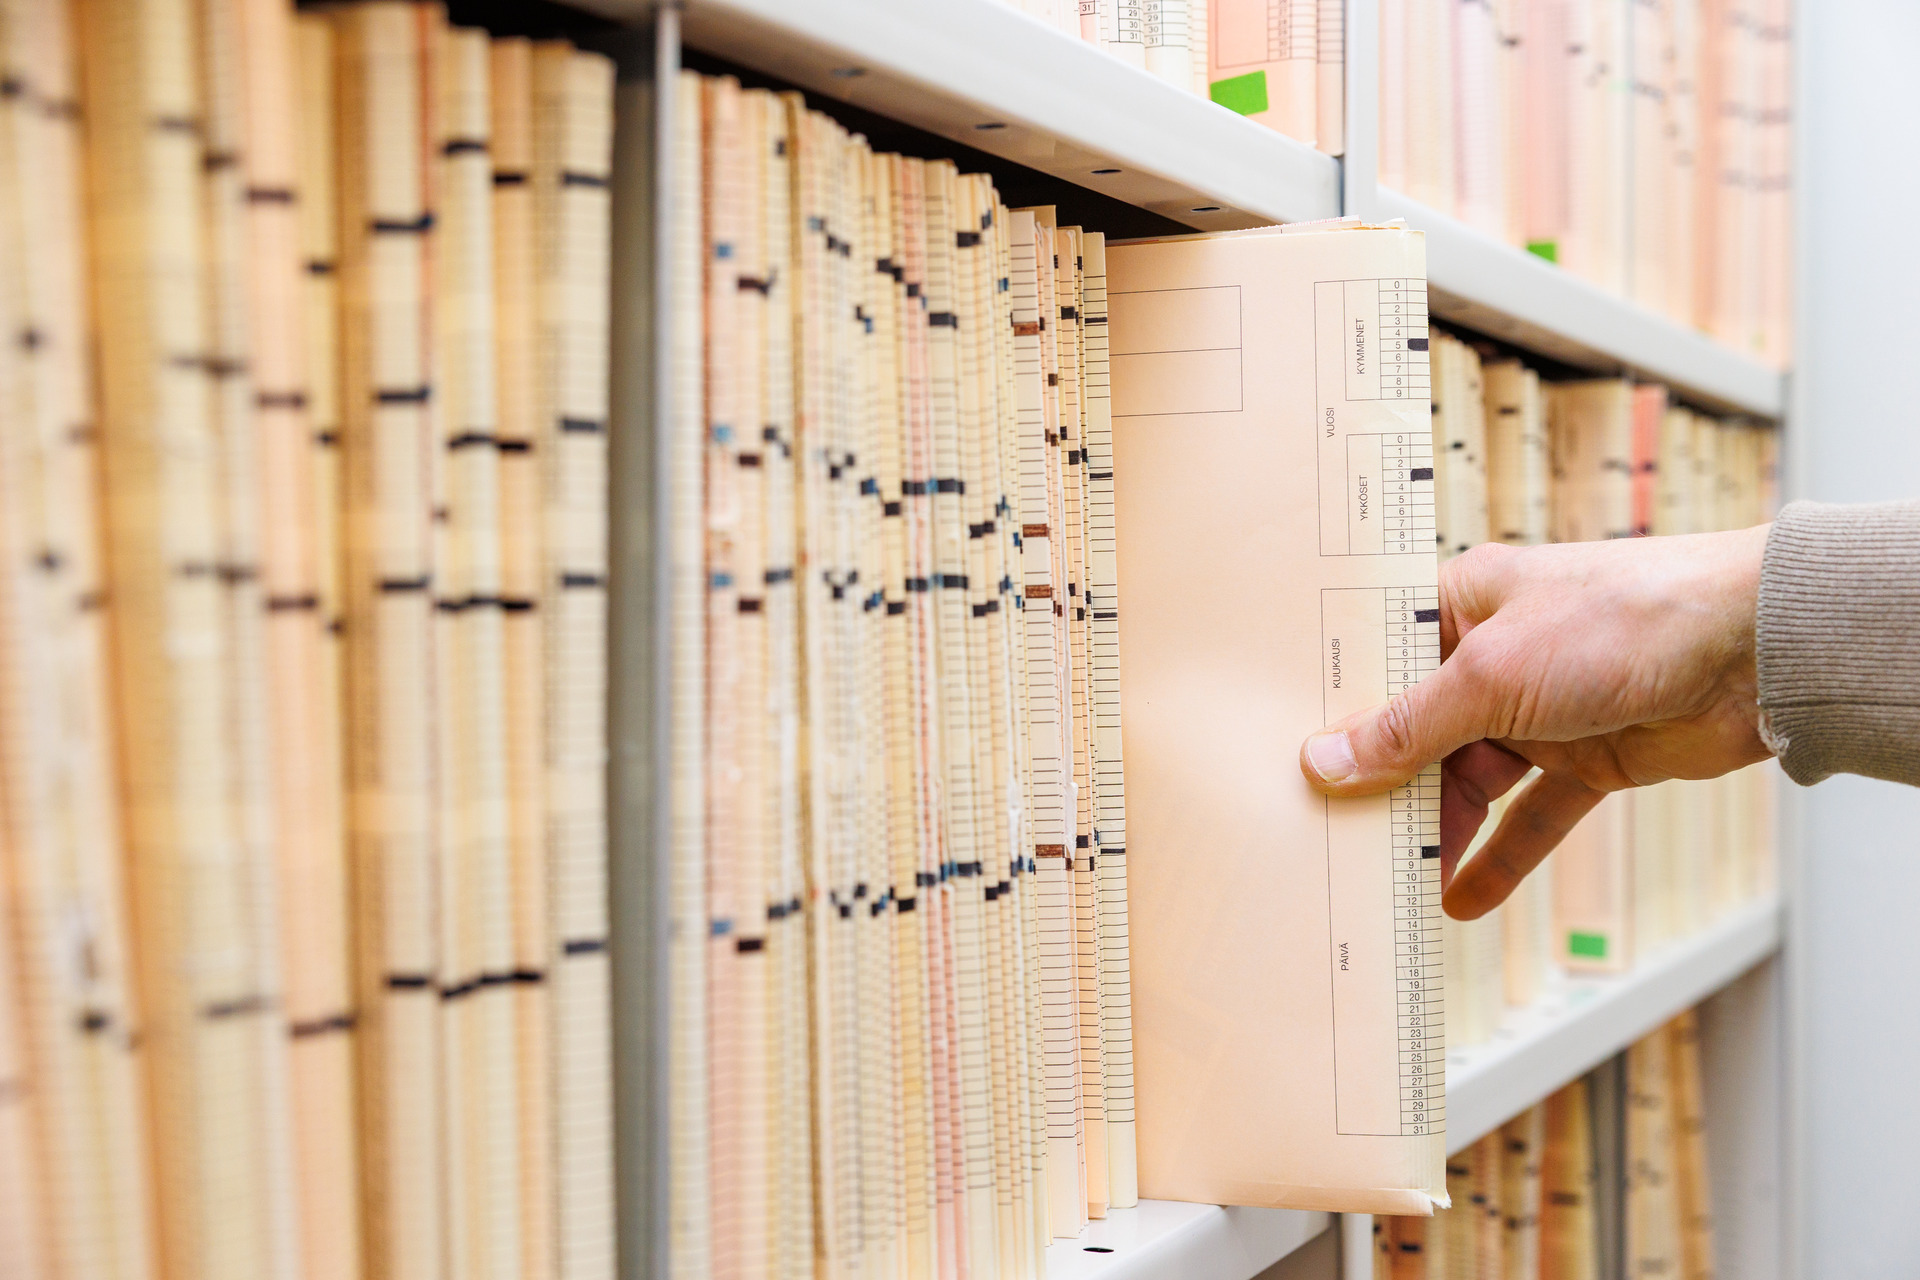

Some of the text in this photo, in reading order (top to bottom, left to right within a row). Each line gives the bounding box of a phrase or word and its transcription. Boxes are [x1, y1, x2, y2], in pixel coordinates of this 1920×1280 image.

[1082, 4, 1091, 12] 31
[1128, 9, 1138, 17] 29
[1129, 21, 1138, 29] 30
[1394, 281, 1400, 289] 0
[1395, 305, 1401, 313] 2
[1395, 317, 1401, 325] 3
[1356, 318, 1365, 375] KYMMENET
[1396, 341, 1402, 349] 5
[1396, 353, 1402, 361] 6
[1396, 365, 1402, 373] 7
[1396, 377, 1402, 385] 8
[1396, 389, 1402, 397] 9
[1326, 407, 1335, 438] VUOSI
[1398, 435, 1403, 443] 0
[1398, 459, 1404, 467] 2
[1398, 471, 1404, 479] 3
[1398, 483, 1404, 491] 4
[1358, 475, 1368, 521] YKKÖSET
[1400, 519, 1405, 527] 7
[1400, 531, 1406, 539] 8
[1400, 543, 1406, 551] 9
[1401, 601, 1407, 609] 2
[1402, 613, 1408, 621] 3
[1402, 637, 1408, 645] 5
[1332, 638, 1341, 689] KUUKAUSI
[1406, 790, 1412, 798] 3
[1407, 813, 1413, 821] 5
[1408, 825, 1414, 833] 6
[1408, 837, 1414, 845] 7
[1408, 849, 1414, 857] 8
[1409, 861, 1415, 869] 9
[1406, 873, 1416, 881] 10
[1406, 897, 1417, 905] 12
[1407, 909, 1417, 917] 13
[1408, 933, 1418, 941] 15
[1408, 945, 1418, 953] 16
[1339, 942, 1349, 971] PÄIVÄ
[1409, 969, 1419, 977] 18
[1409, 981, 1419, 989] 19
[1409, 993, 1420, 1001] 20
[1410, 1005, 1419, 1013] 21
[1410, 1017, 1420, 1025] 22
[1411, 1029, 1421, 1037] 23
[1411, 1041, 1421, 1049] 24
[1411, 1053, 1422, 1061] 25
[1412, 1065, 1422, 1073] 26
[1412, 1077, 1422, 1085] 27
[1413, 1089, 1423, 1097] 28
[1413, 1101, 1423, 1109] 29
[1413, 1114, 1423, 1122] 30
[1413, 1126, 1424, 1134] 31
